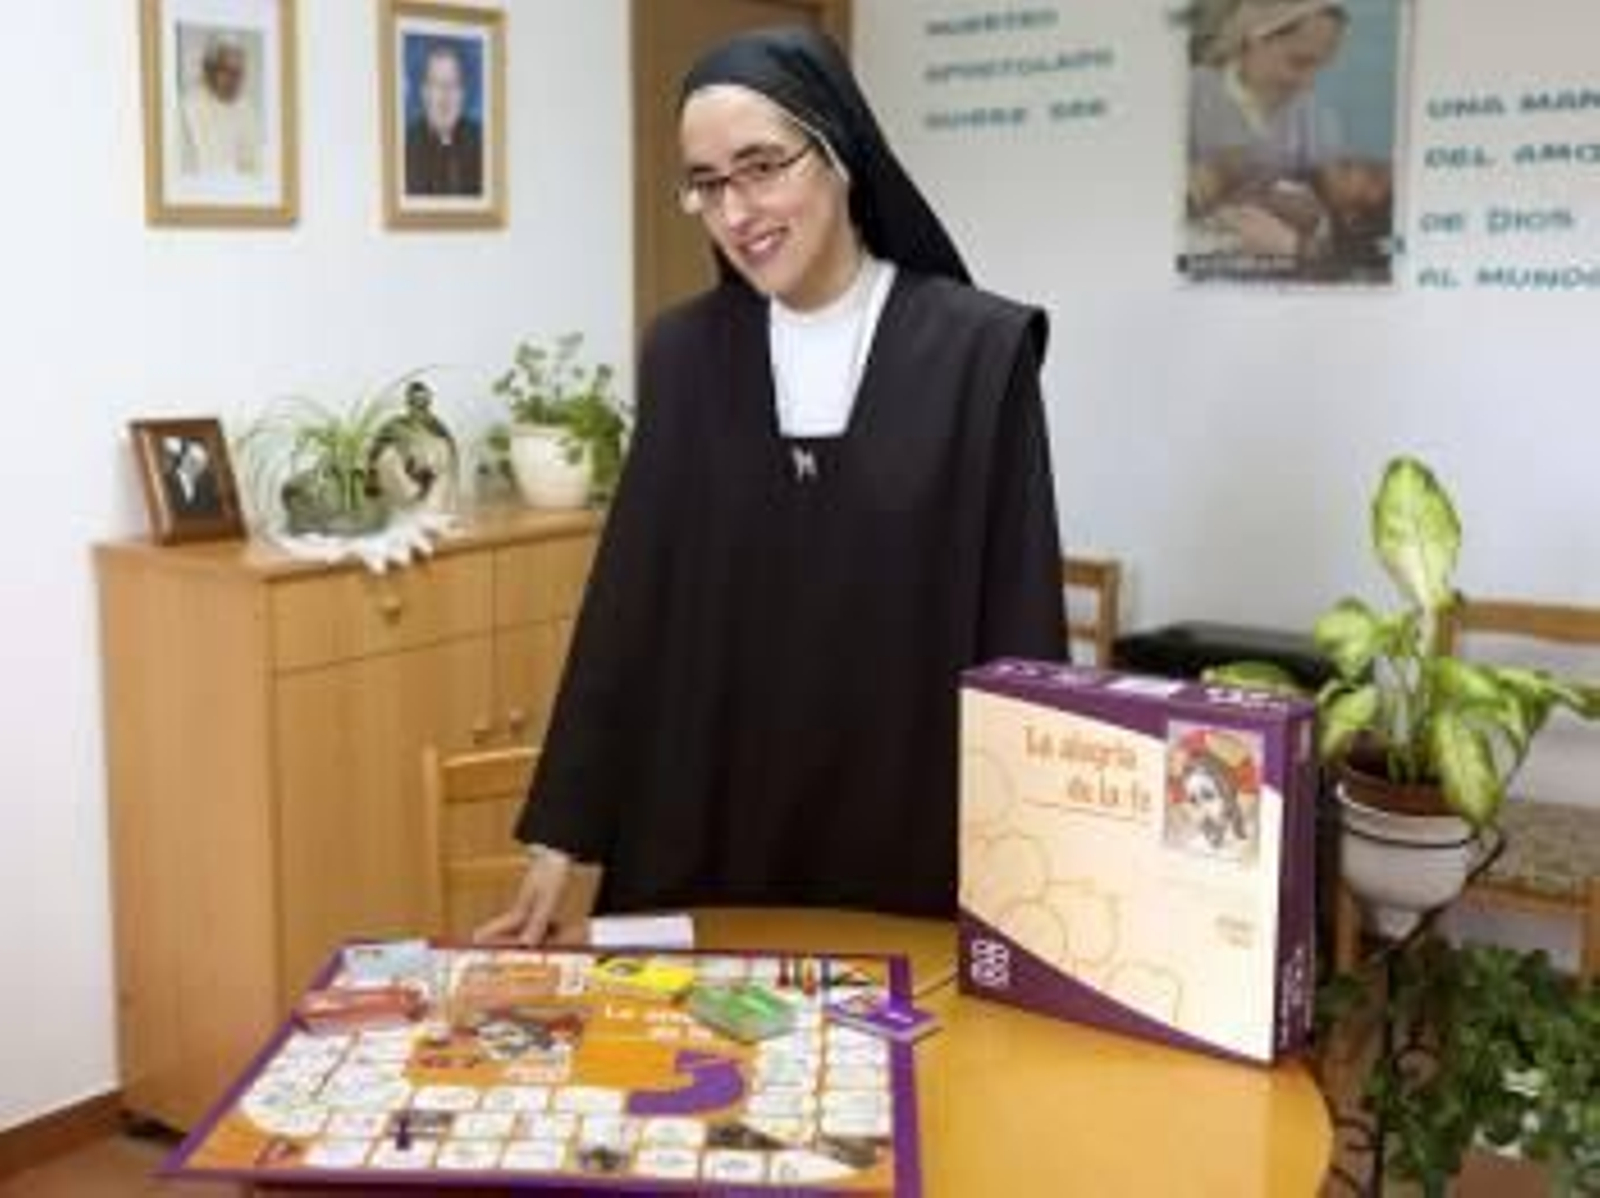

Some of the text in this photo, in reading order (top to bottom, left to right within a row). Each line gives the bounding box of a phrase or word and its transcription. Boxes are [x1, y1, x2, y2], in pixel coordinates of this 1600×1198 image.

[1427, 96, 1504, 119] UNA
[1424, 146, 1497, 168] DEL
[1487, 207, 1573, 235] DIOS
[1418, 267, 1460, 288] AL
